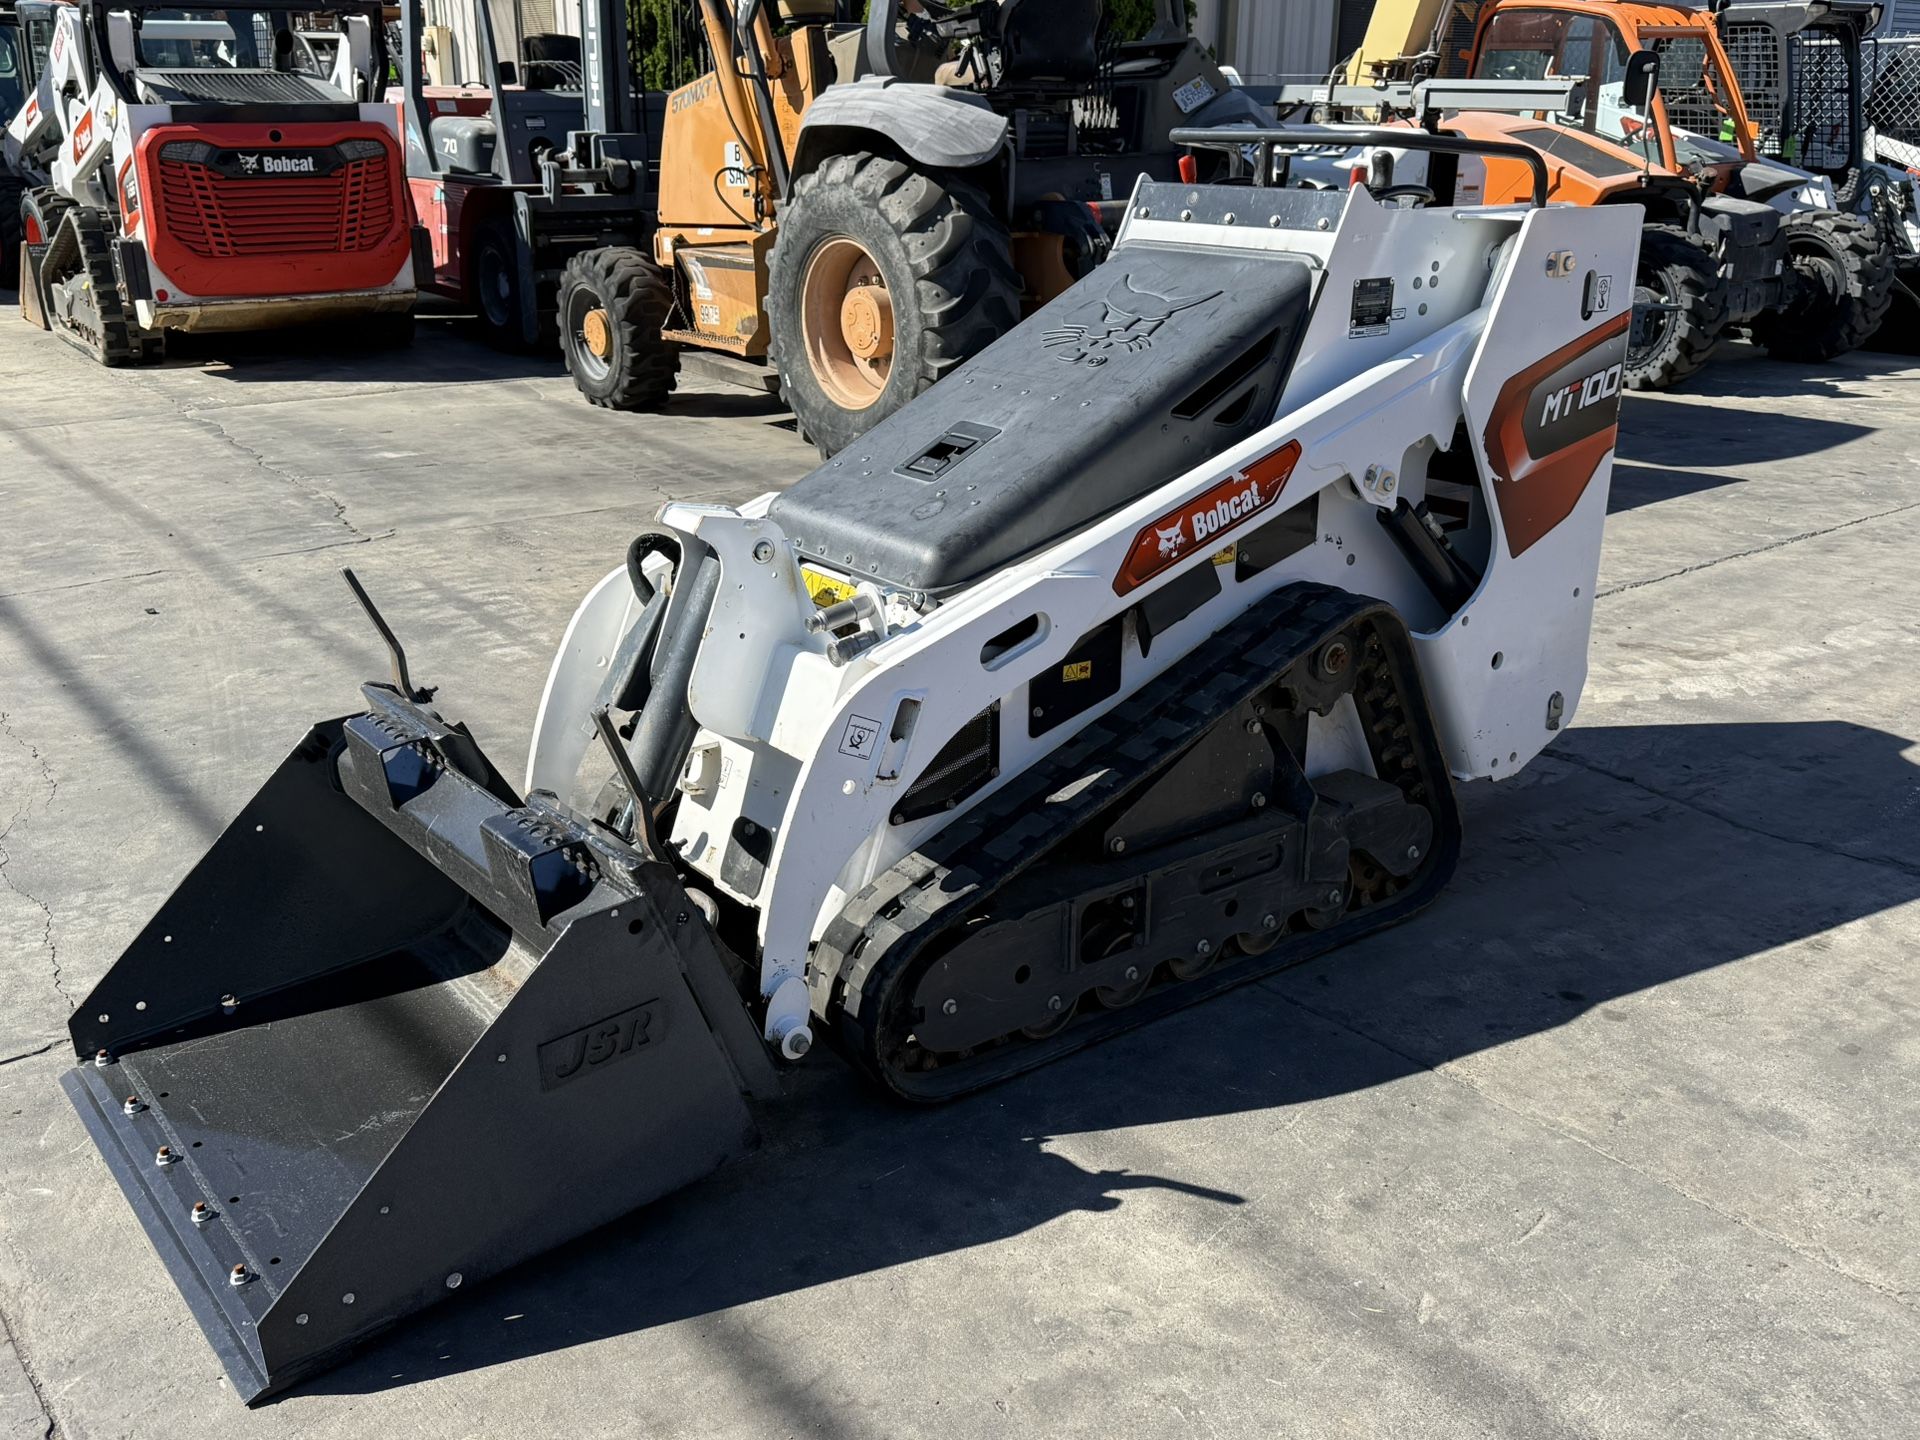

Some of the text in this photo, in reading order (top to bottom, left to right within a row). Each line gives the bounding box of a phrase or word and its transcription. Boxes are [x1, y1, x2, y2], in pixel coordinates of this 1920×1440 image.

[588, 31, 600, 107] HELI
[263, 156, 315, 173] Bobcat
[442, 138, 458, 153] 70
[1540, 362, 1622, 428] MT100
[1192, 480, 1261, 542] Bobcat
[555, 1011, 653, 1079] JSR
